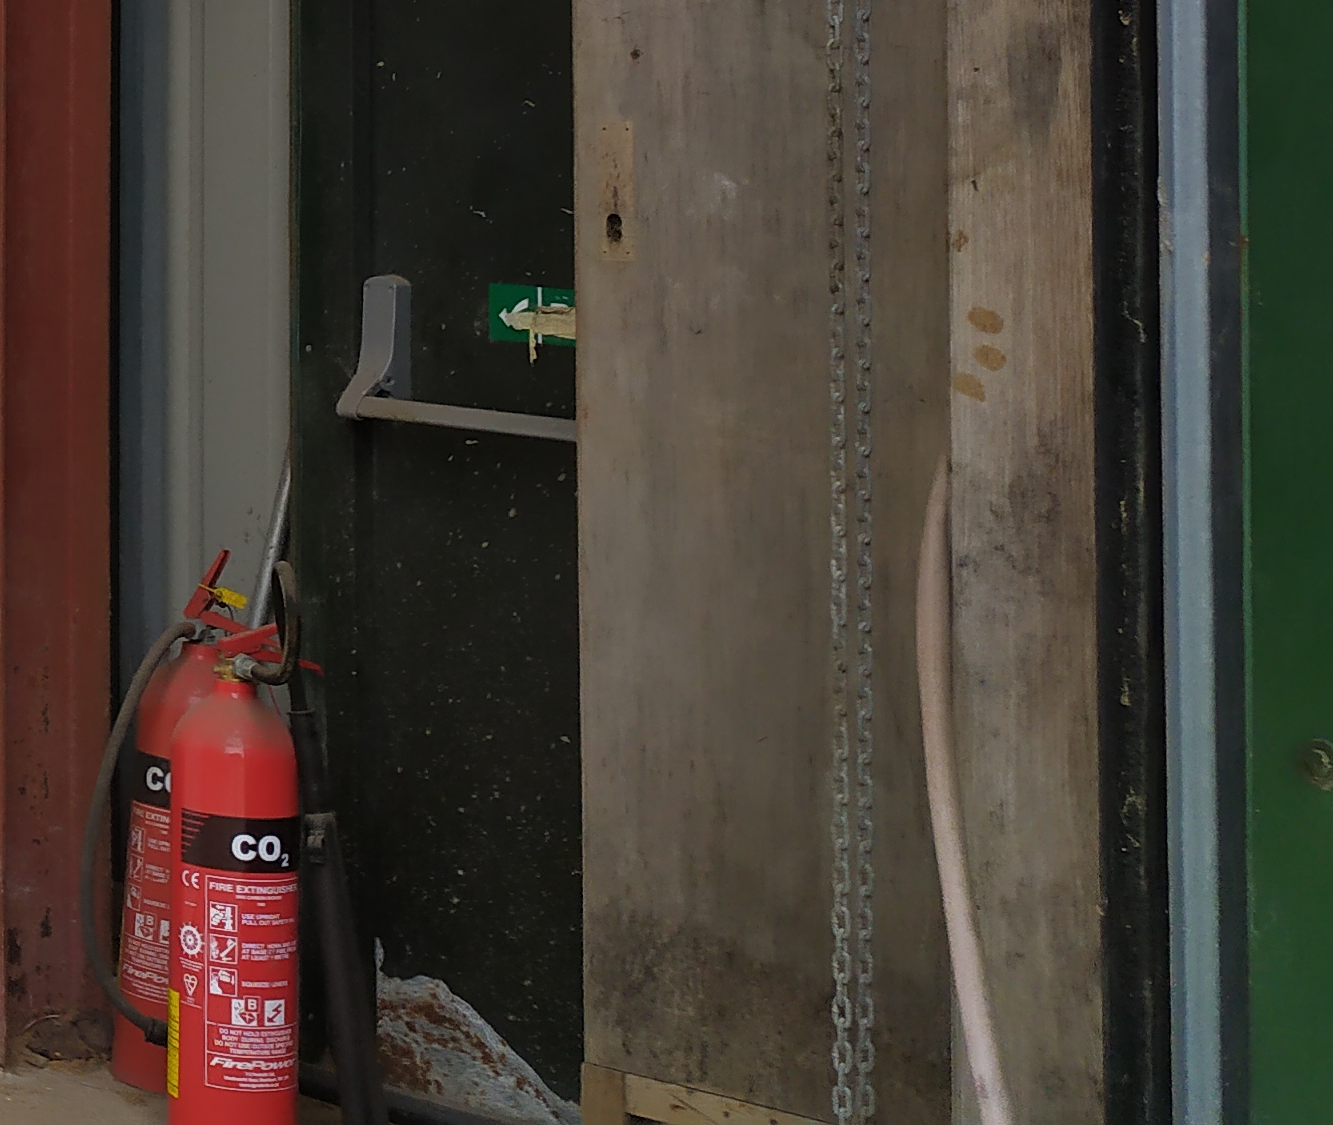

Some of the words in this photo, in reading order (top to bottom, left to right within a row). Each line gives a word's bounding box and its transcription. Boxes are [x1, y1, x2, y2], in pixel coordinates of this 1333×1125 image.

[145, 766, 171, 793] C
[231, 834, 290, 867] CO2
[209, 881, 234, 893] FIRE
[248, 1000, 258, 1011] B
